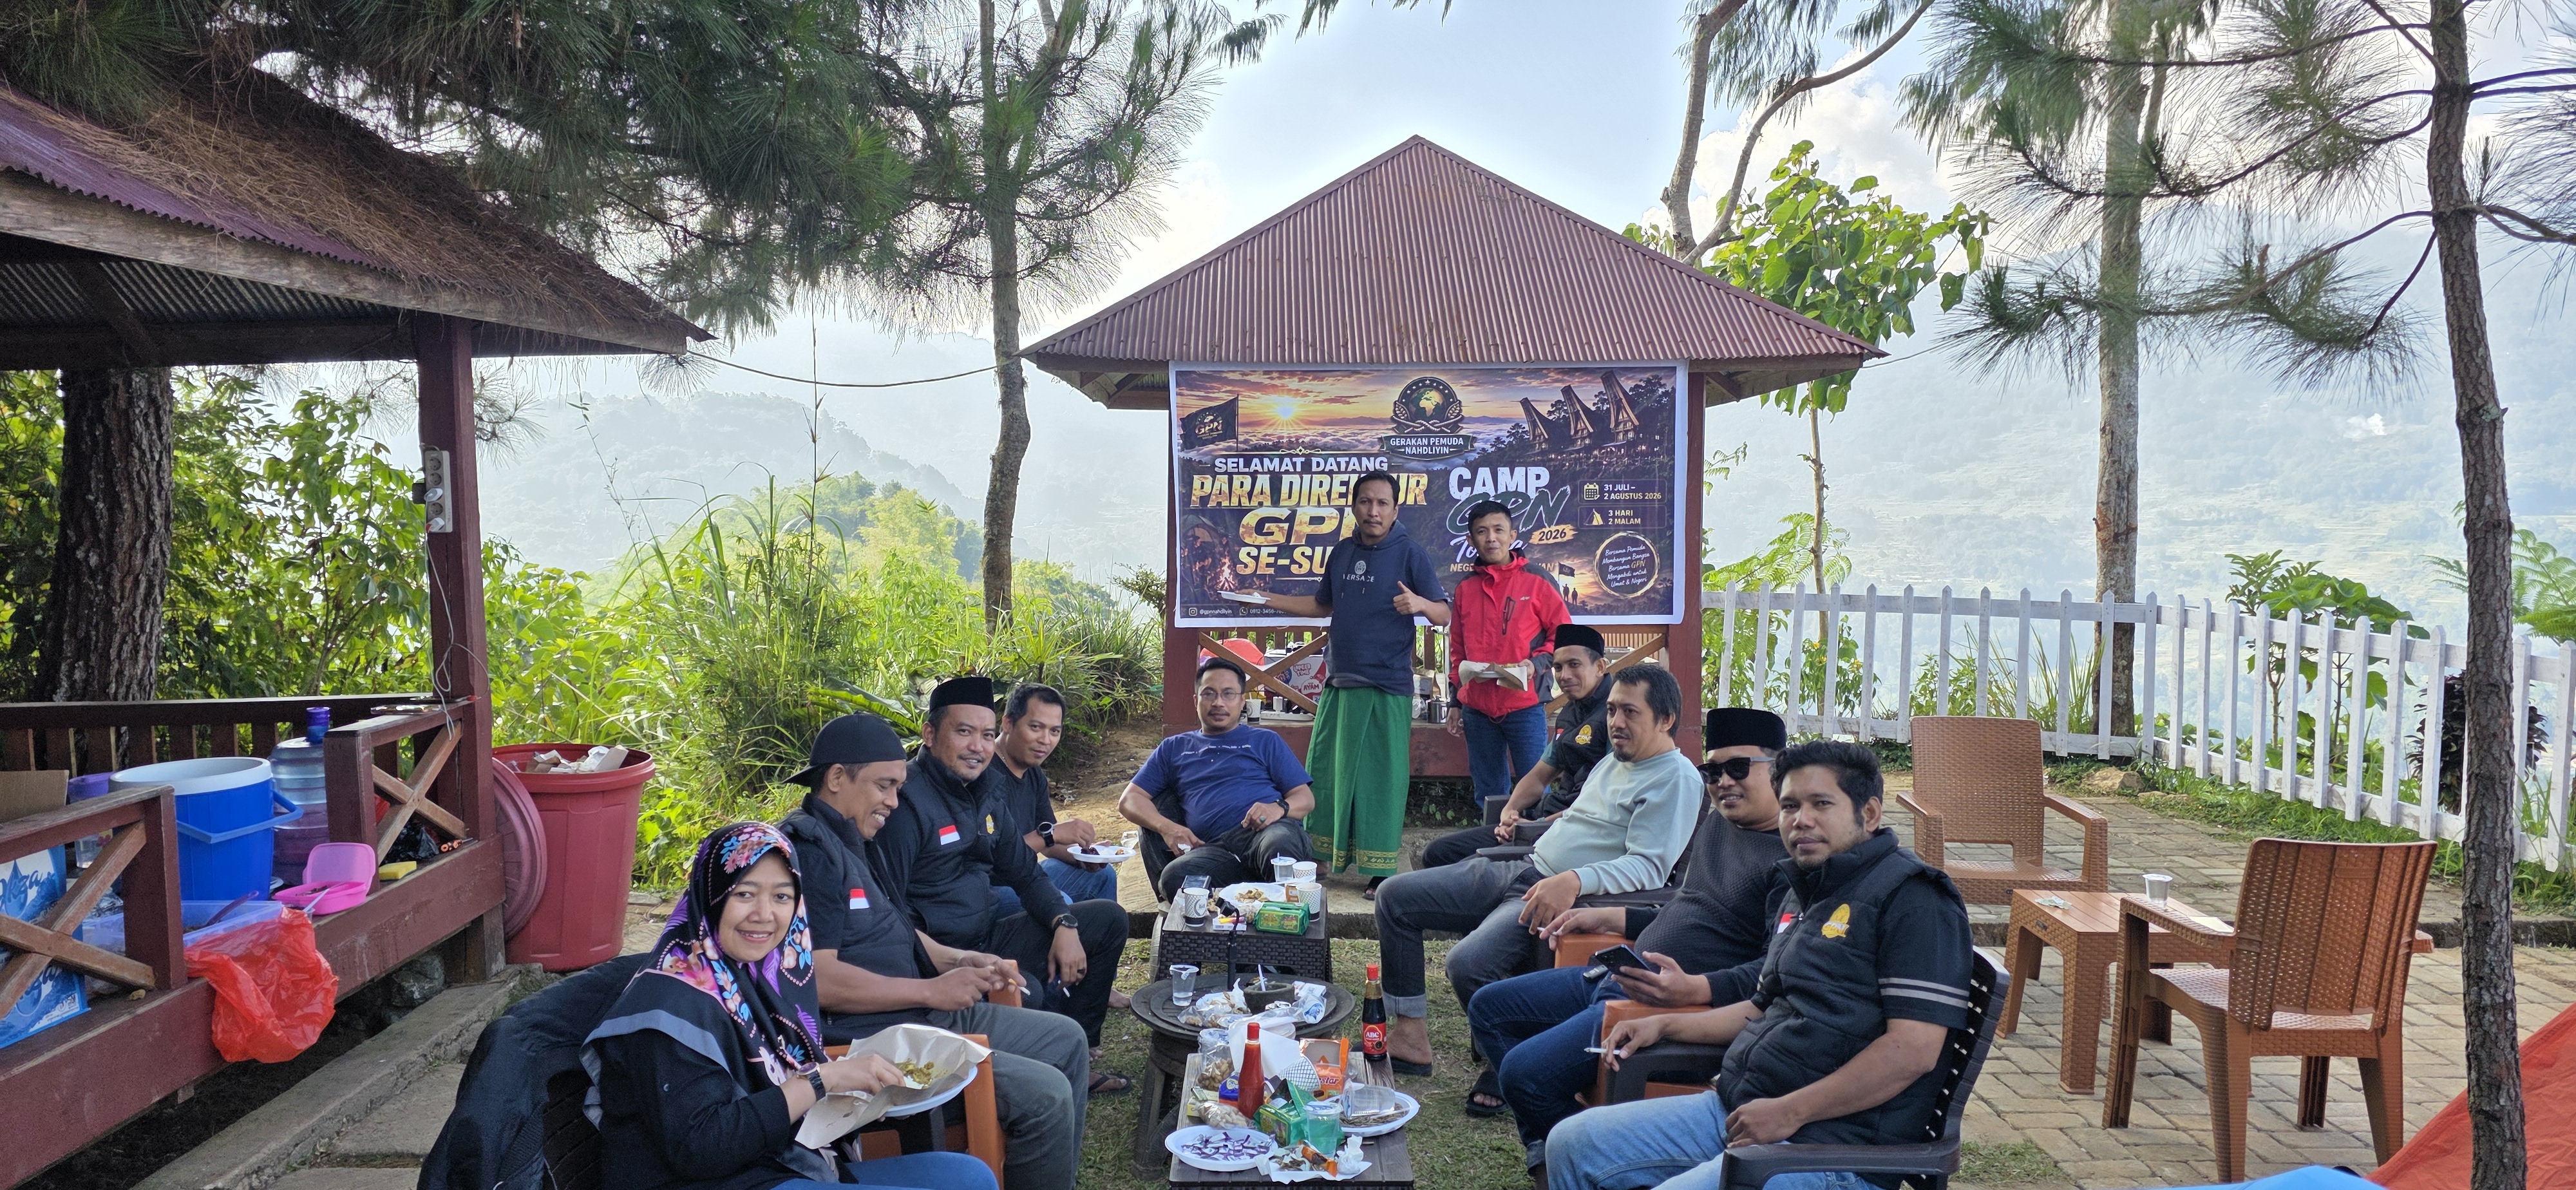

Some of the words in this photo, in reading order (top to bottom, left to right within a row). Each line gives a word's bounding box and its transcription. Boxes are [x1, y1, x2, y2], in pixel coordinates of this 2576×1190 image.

[1214, 457, 1305, 473] SELAMAT
[1311, 457, 1388, 471] DATANG
[1190, 475, 1273, 507] PARA
[1449, 467, 1550, 500] CAMP
[1446, 485, 1571, 534] GPN
[1539, 527, 1567, 542] 2026
[1627, 544, 1646, 552] Pemuda
[1236, 546, 1334, 574] SE-SU
[1631, 560, 1646, 569] GPN
